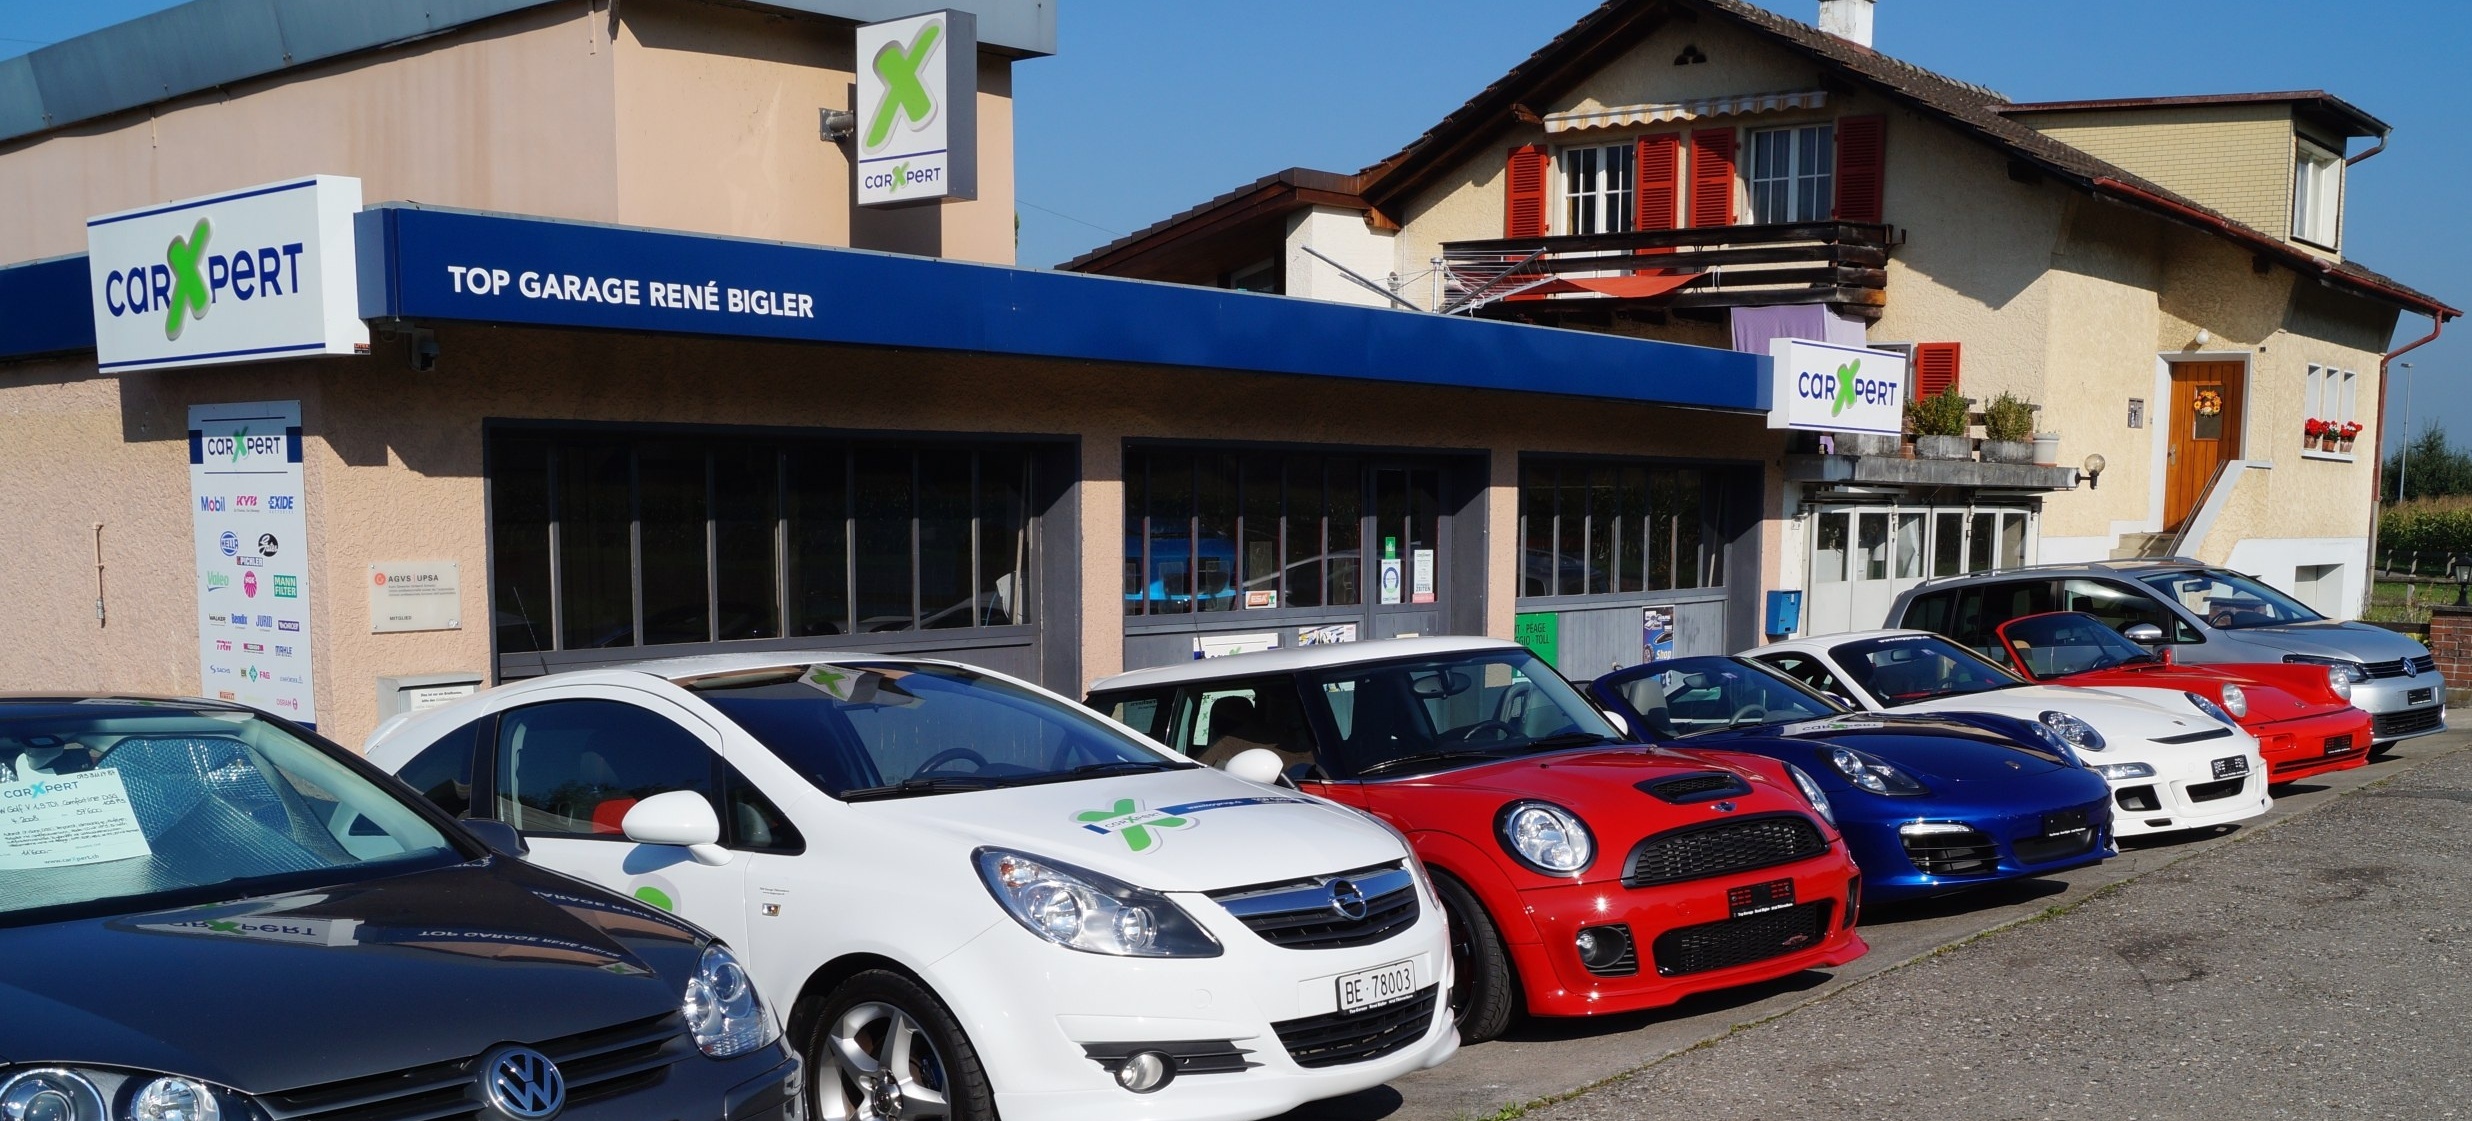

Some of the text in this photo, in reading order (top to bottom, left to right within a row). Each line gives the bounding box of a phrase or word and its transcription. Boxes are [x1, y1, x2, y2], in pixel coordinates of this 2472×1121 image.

[448, 266, 814, 318] TOP GARAGE RENÉ BIGLER
[201, 495, 226, 512] Mobil
[269, 495, 293, 510] EXIDE
[274, 576, 295, 586] MANN
[388, 574, 439, 583] AGVS UPSA
[275, 585, 297, 596] FILTER
[1535, 634, 1550, 645] TOLL
[1655, 649, 1672, 660] Shop
[1345, 968, 1411, 1005] BE 78003
